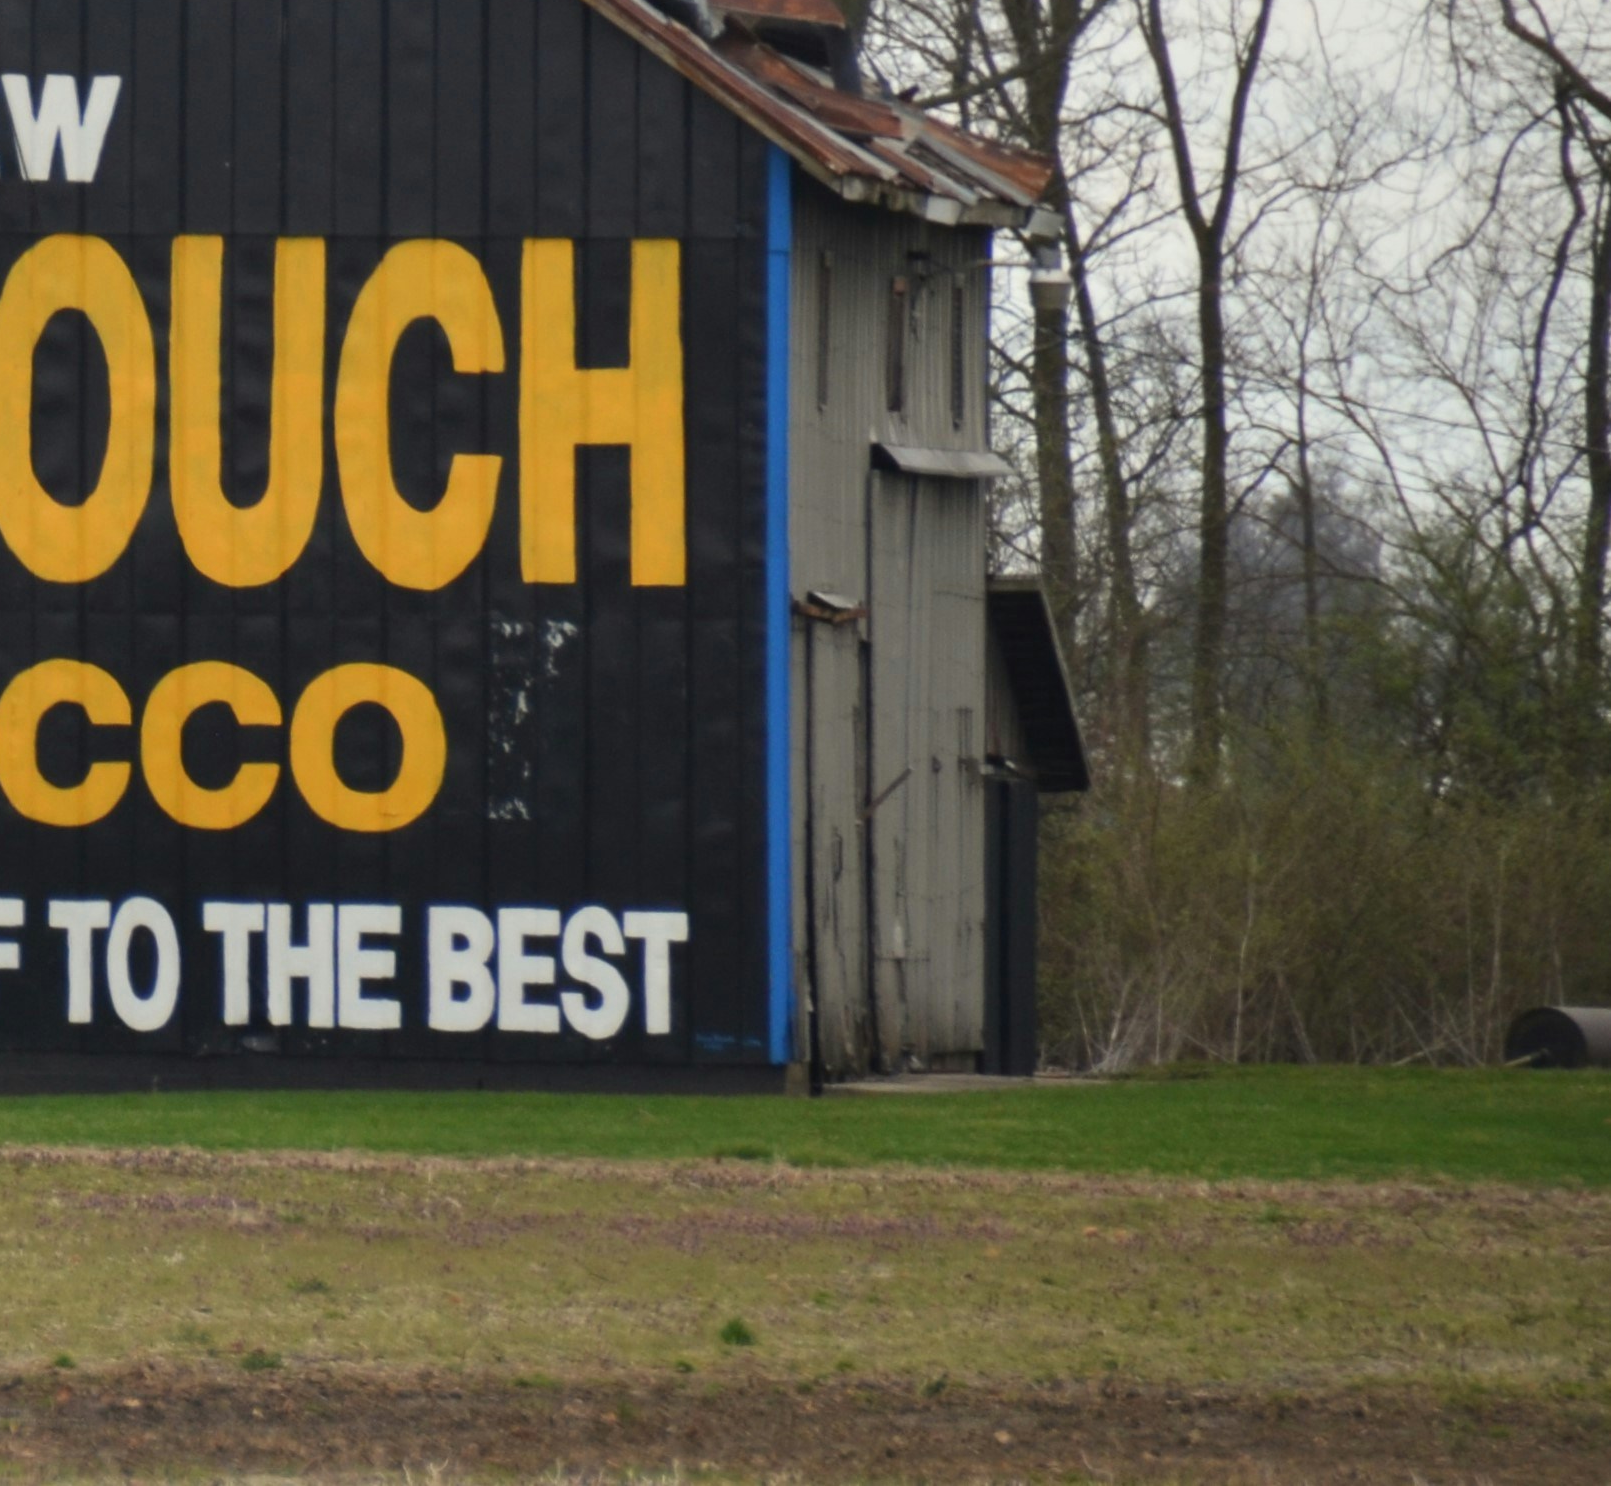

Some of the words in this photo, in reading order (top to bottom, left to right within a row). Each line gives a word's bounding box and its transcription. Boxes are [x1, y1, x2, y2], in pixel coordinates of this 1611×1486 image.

[48, 900, 180, 1032] TO
[203, 902, 402, 1030] THE
[428, 906, 689, 1040] BEST
